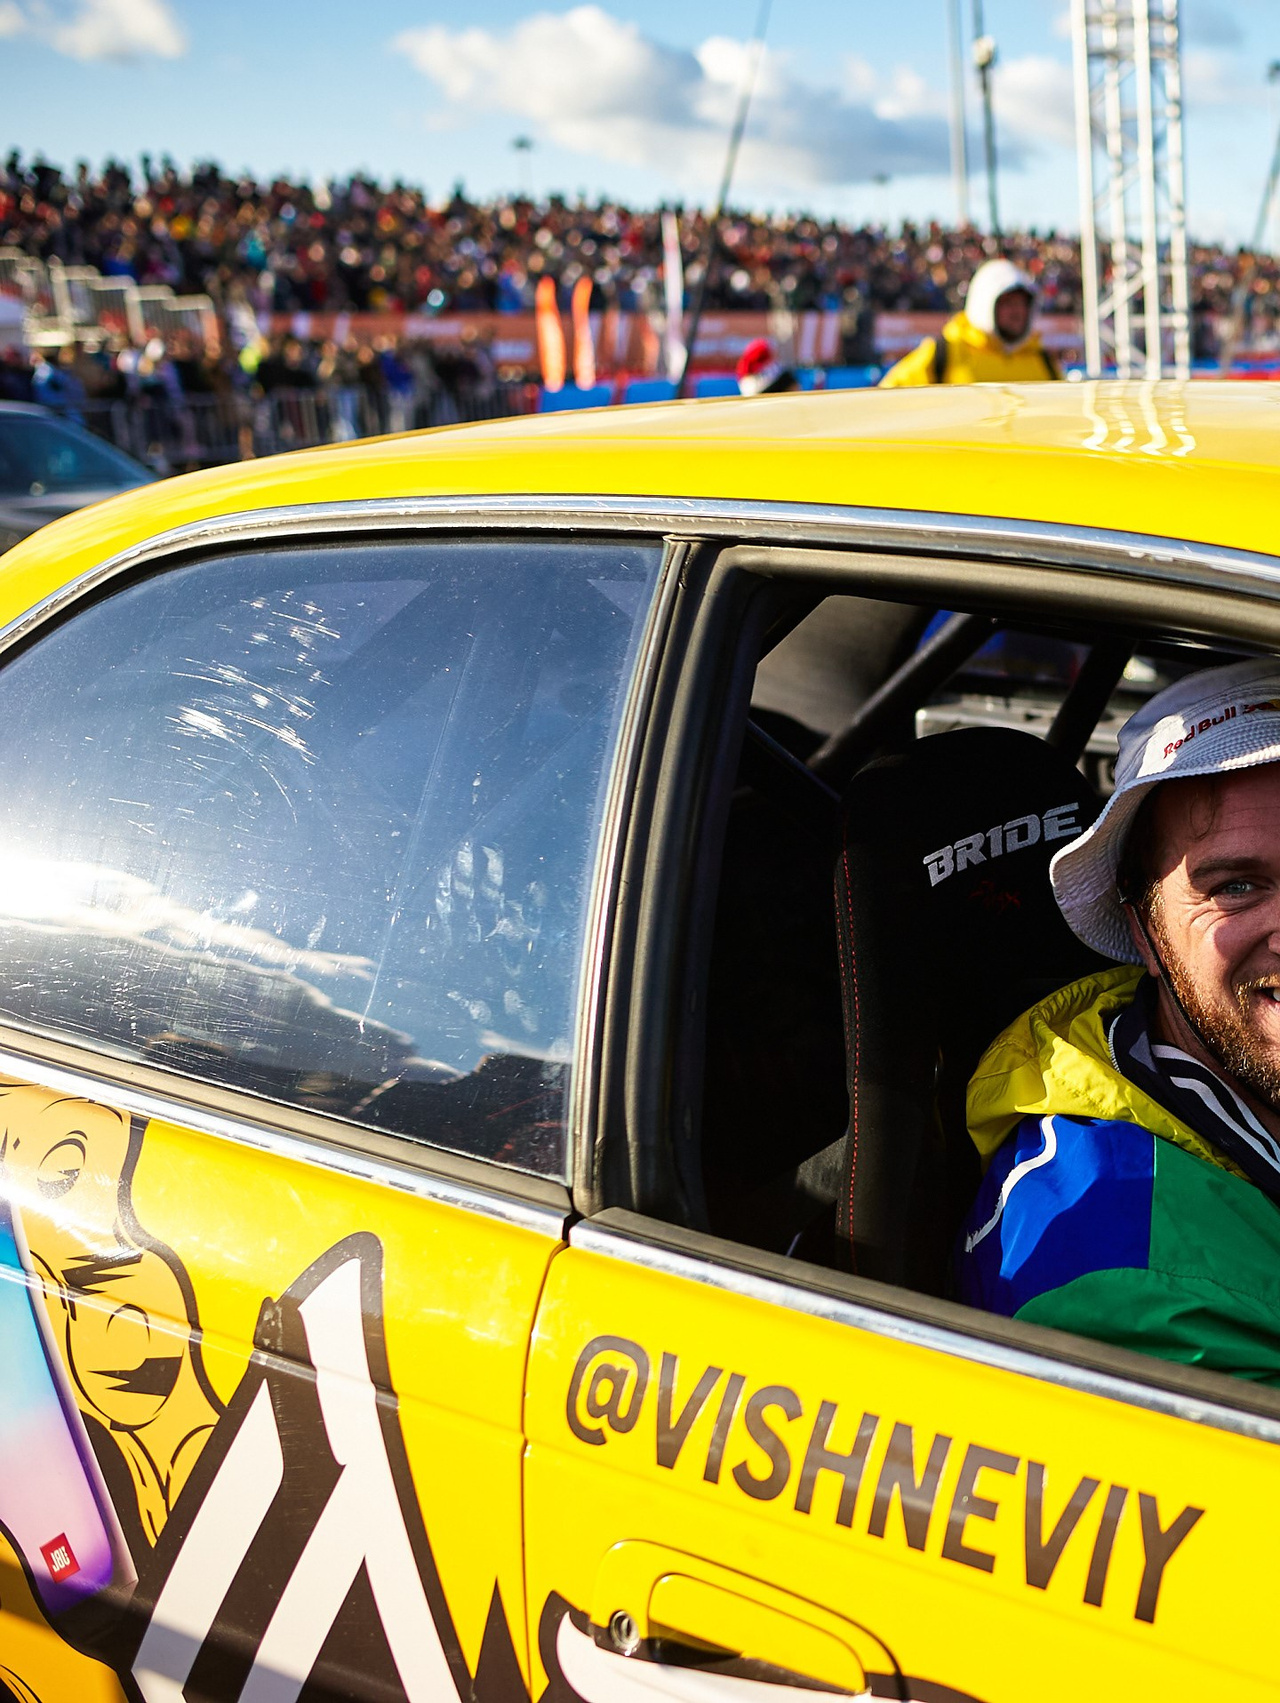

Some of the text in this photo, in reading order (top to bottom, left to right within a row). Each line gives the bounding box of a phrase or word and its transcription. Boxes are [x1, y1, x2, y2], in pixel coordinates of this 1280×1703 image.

[1163, 706, 1236, 759] Red Bull
[923, 802, 1082, 888] BRIDE
[565, 1334, 1206, 1625] @VISHNEVIY
